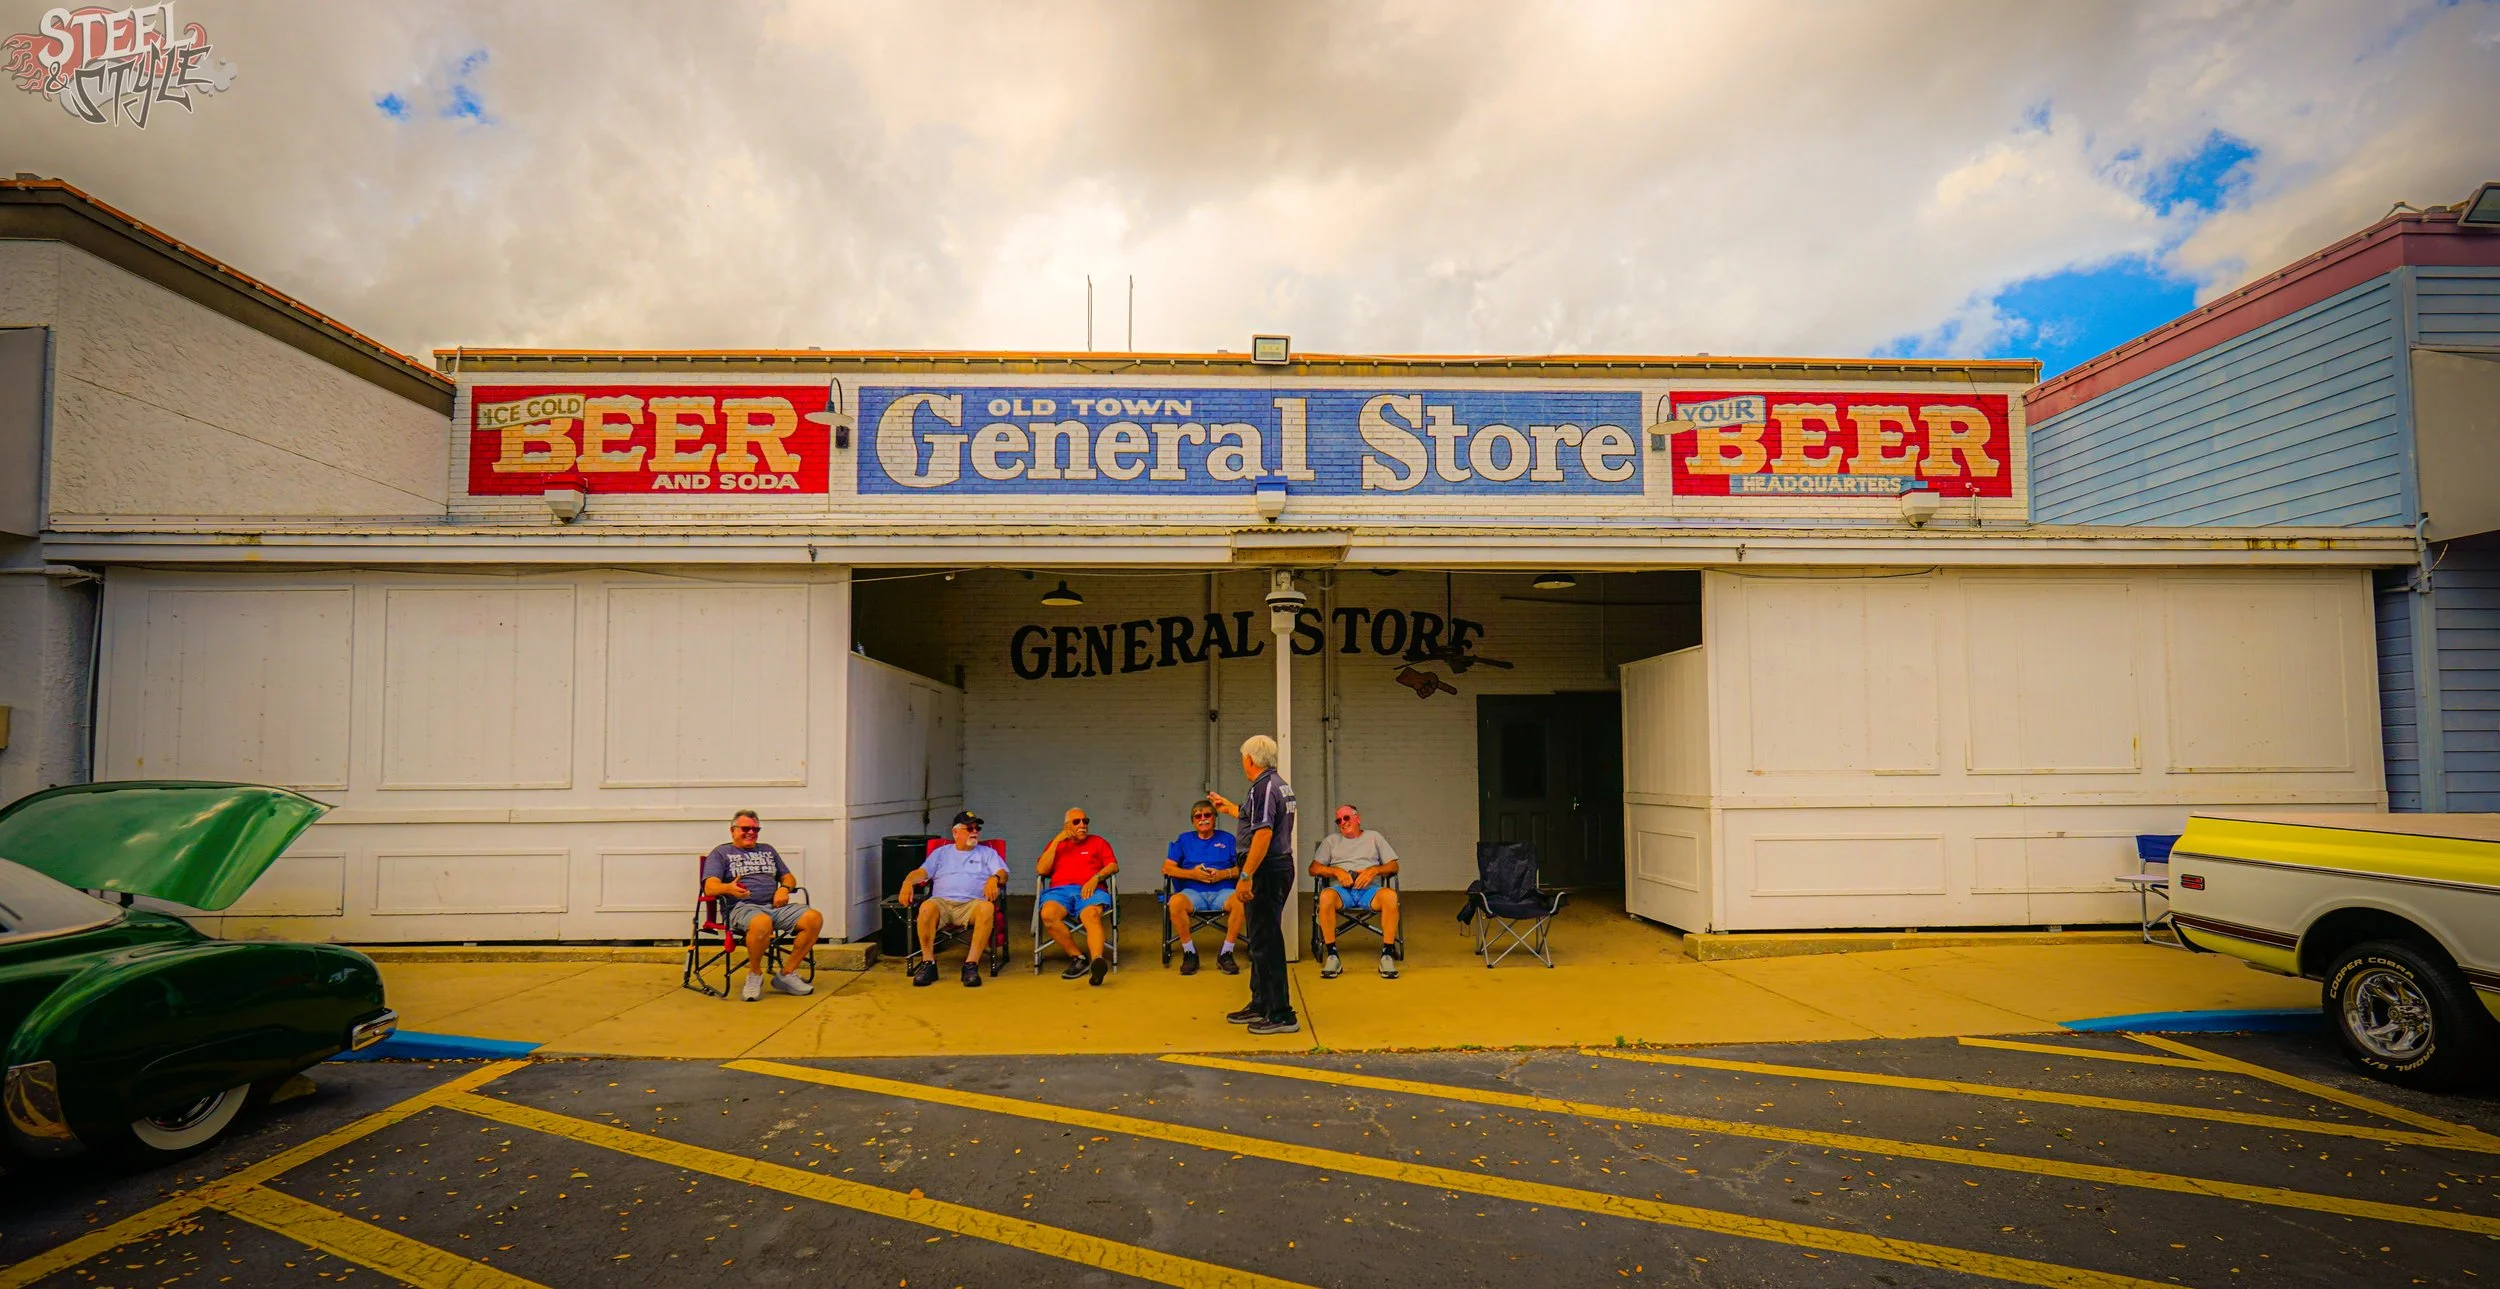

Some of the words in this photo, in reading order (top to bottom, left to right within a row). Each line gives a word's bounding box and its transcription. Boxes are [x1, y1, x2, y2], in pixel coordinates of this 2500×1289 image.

[486, 405, 521, 425] ICE
[526, 398, 581, 418] COLD
[987, 399, 1056, 416] OLD
[1071, 399, 1192, 416] TOWN
[1682, 399, 1756, 423] YOUR
[491, 394, 802, 473] BEER
[875, 392, 1316, 489] General
[1357, 393, 1637, 492] Store
[1685, 402, 2000, 478] BEER
[652, 474, 713, 490] AND
[719, 474, 800, 490] SODA
[1742, 476, 1901, 493] HEADQUARTERS
[1010, 611, 1265, 681] GENERAL
[1290, 607, 1484, 664] STORE
[2329, 958, 2363, 999] COOPER
[2368, 957, 2415, 979] COBRA
[2395, 1043, 2436, 1072] RADIAL
